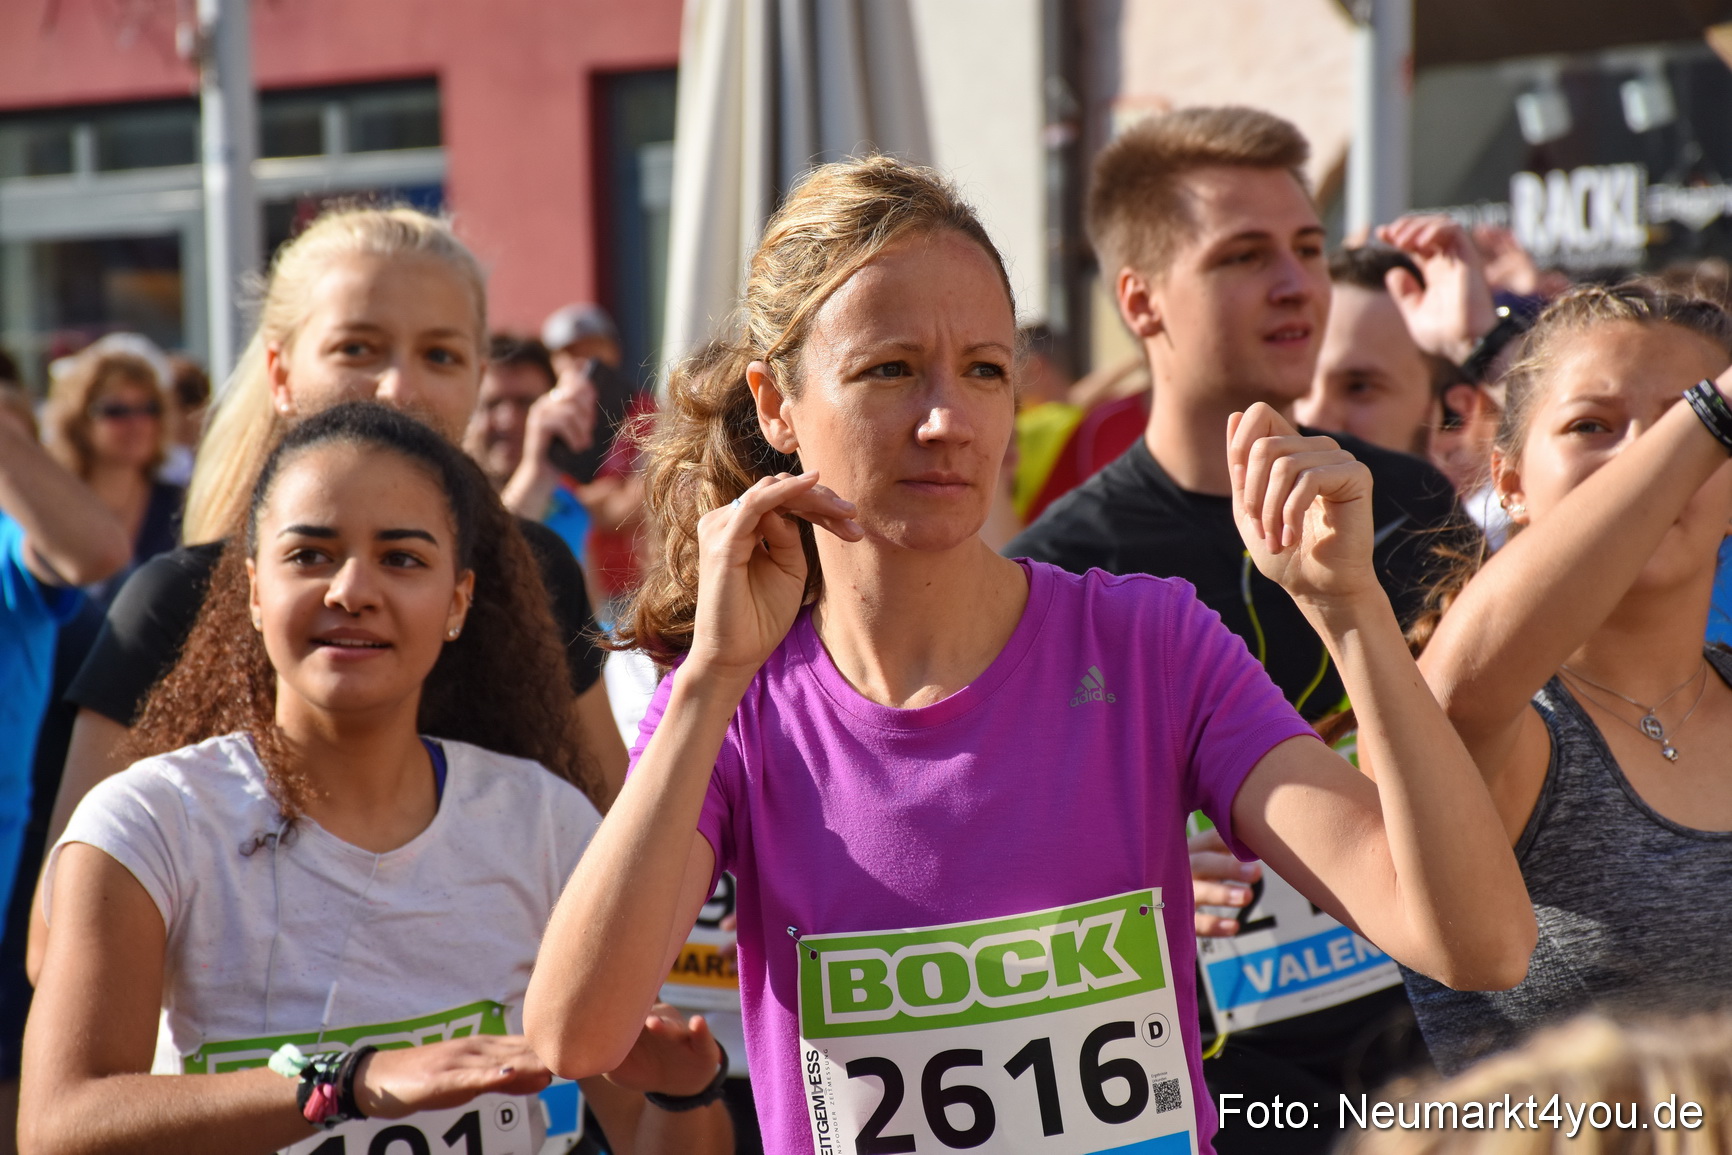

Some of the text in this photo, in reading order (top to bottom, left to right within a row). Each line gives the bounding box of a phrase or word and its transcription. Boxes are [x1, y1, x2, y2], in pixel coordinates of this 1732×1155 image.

[1070, 688, 1116, 707] adidas
[823, 912, 1137, 1021] BOCK
[845, 1021, 1150, 1155] 2616
